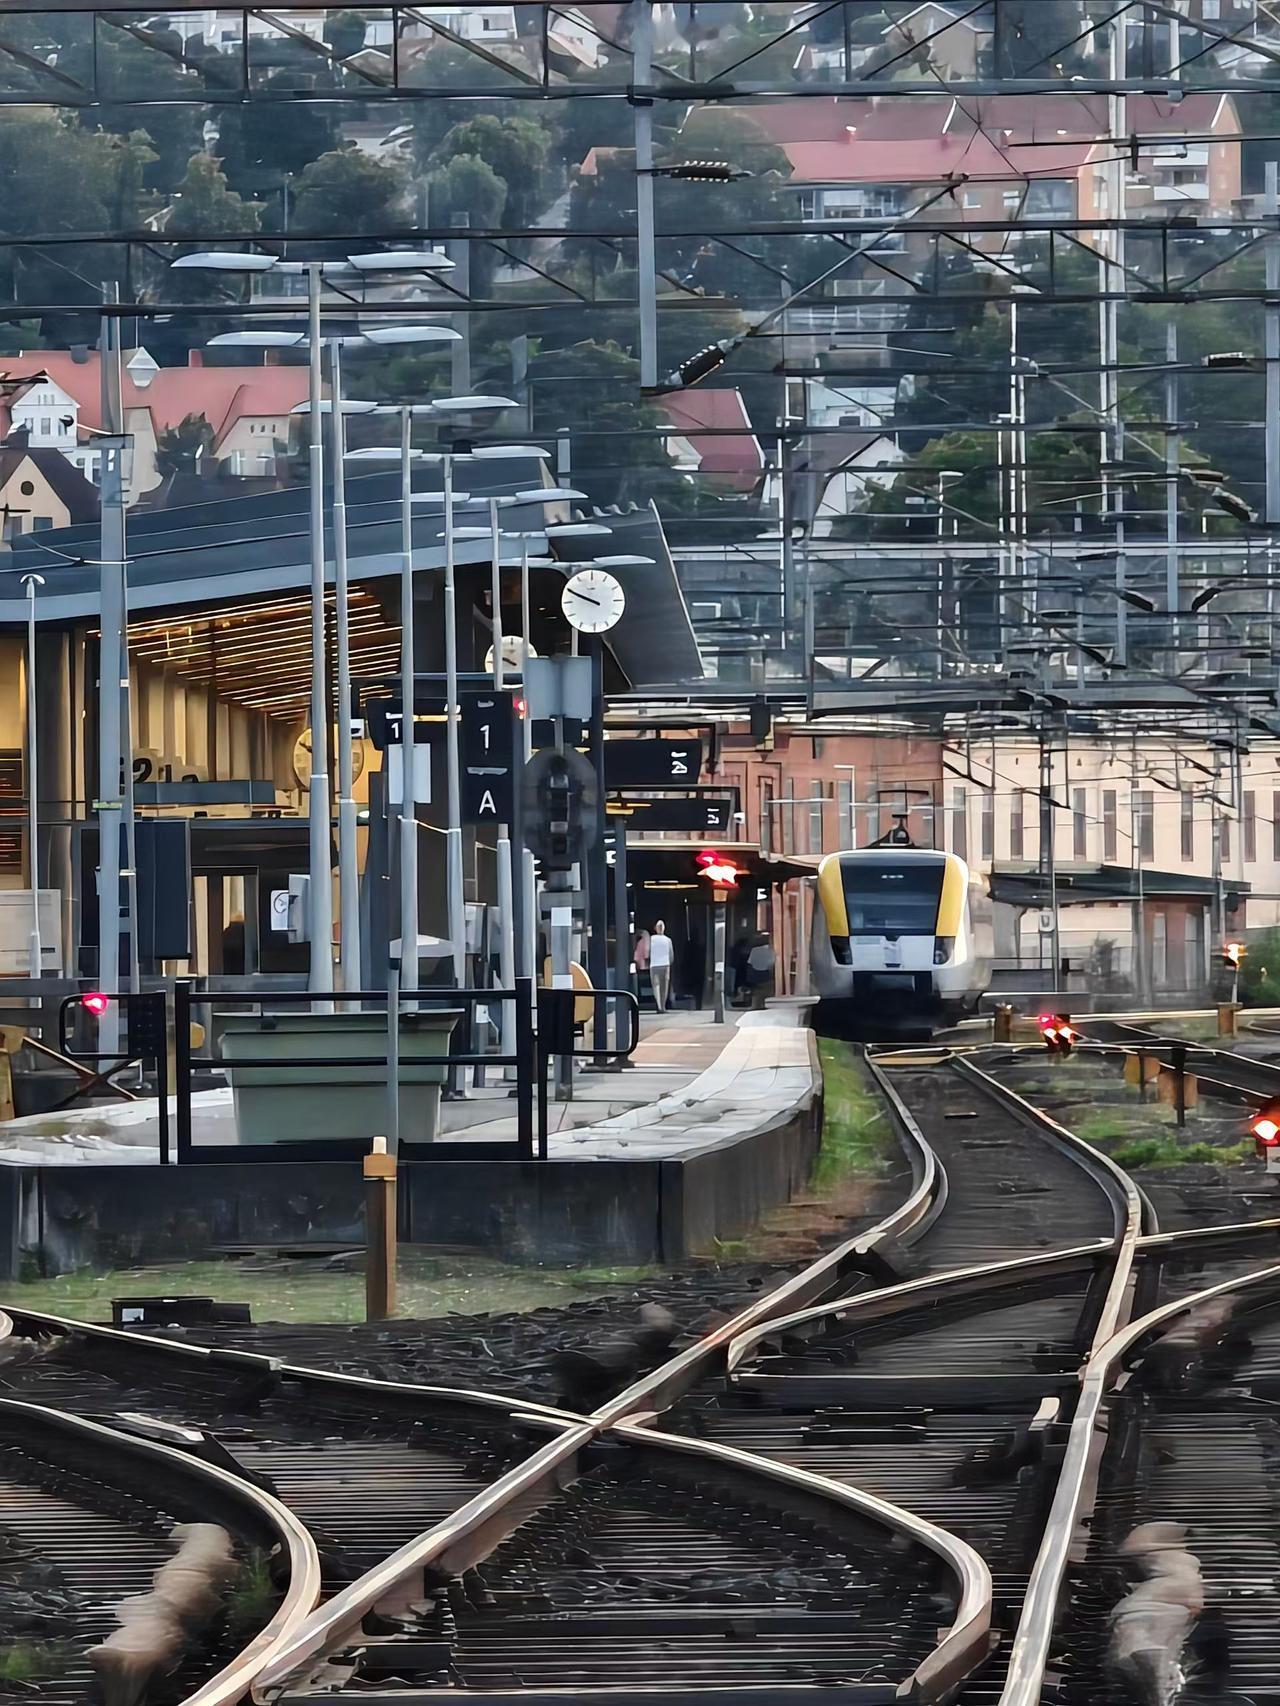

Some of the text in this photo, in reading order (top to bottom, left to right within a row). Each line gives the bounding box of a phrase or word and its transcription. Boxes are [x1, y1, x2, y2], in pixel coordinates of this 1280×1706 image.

[390, 722, 400, 739] 1
[479, 724, 490, 749] 1
[478, 789, 497, 815] A
